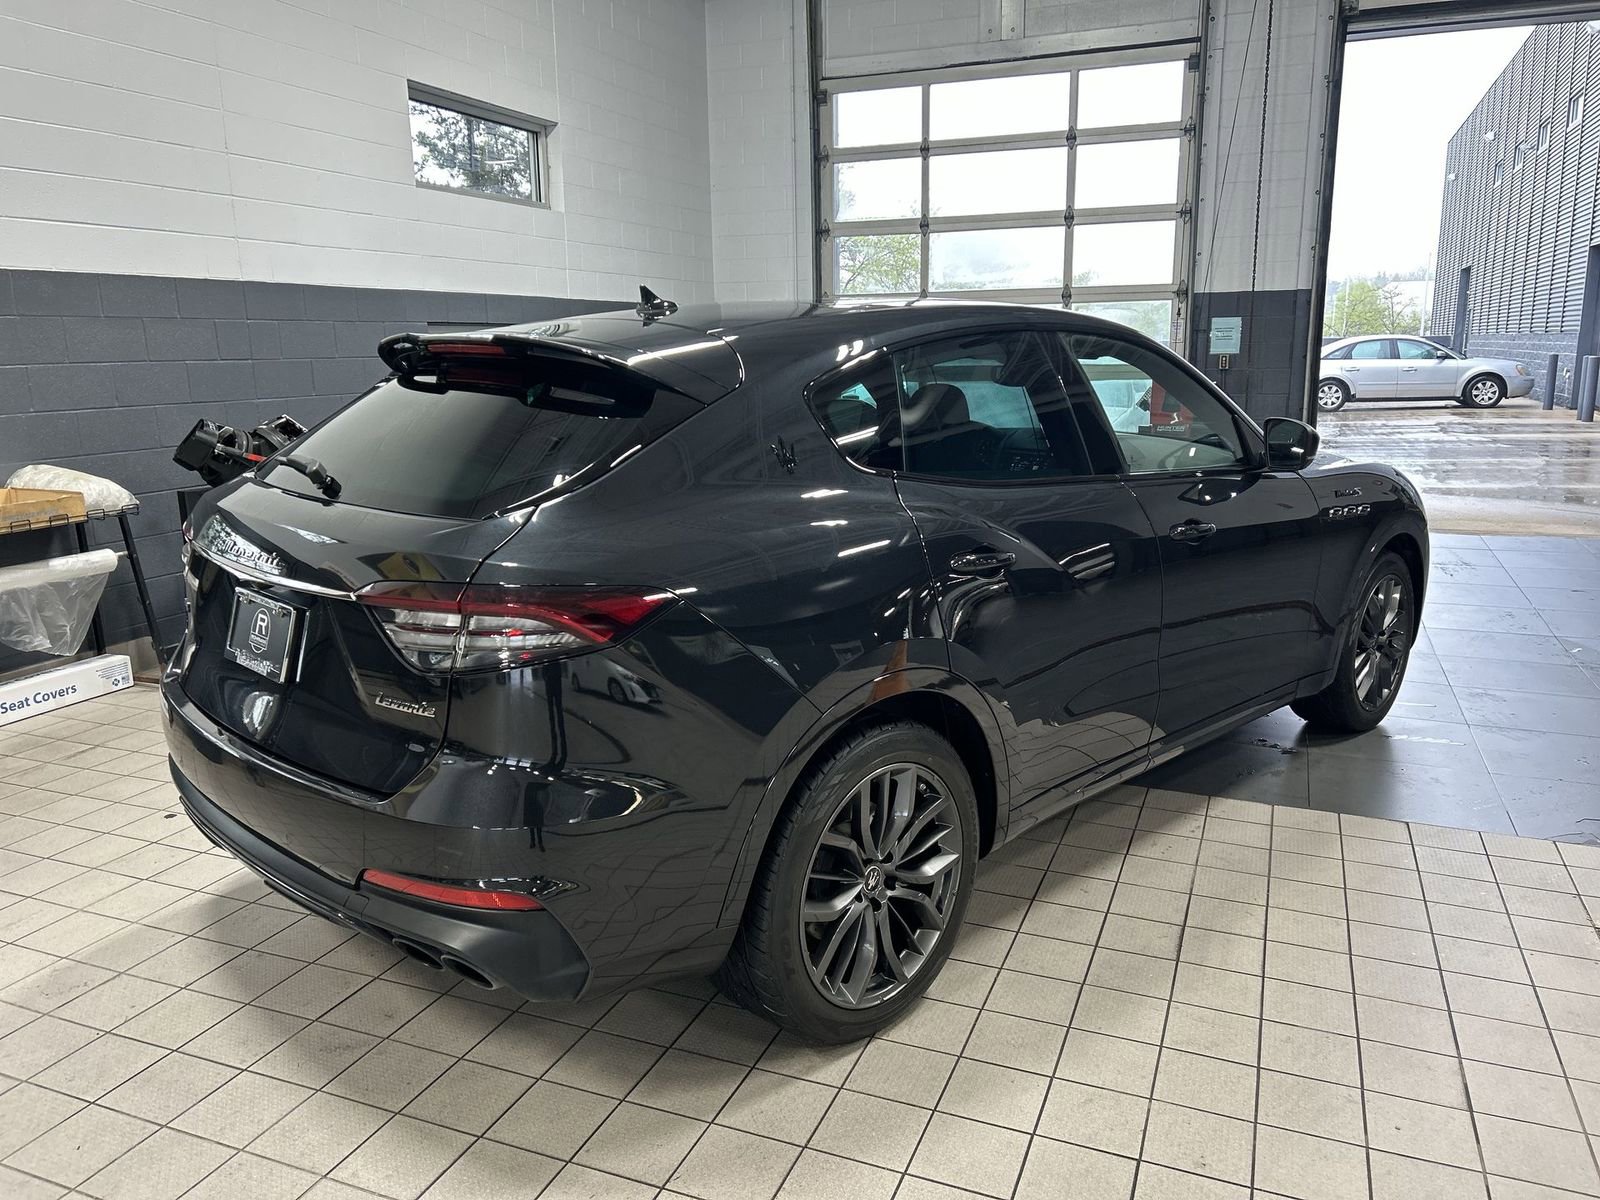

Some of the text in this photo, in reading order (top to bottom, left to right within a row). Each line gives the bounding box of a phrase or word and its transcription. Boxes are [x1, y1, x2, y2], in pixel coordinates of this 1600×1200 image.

[255, 613, 268, 635] R
[0, 684, 77, 714] Seat Covers
